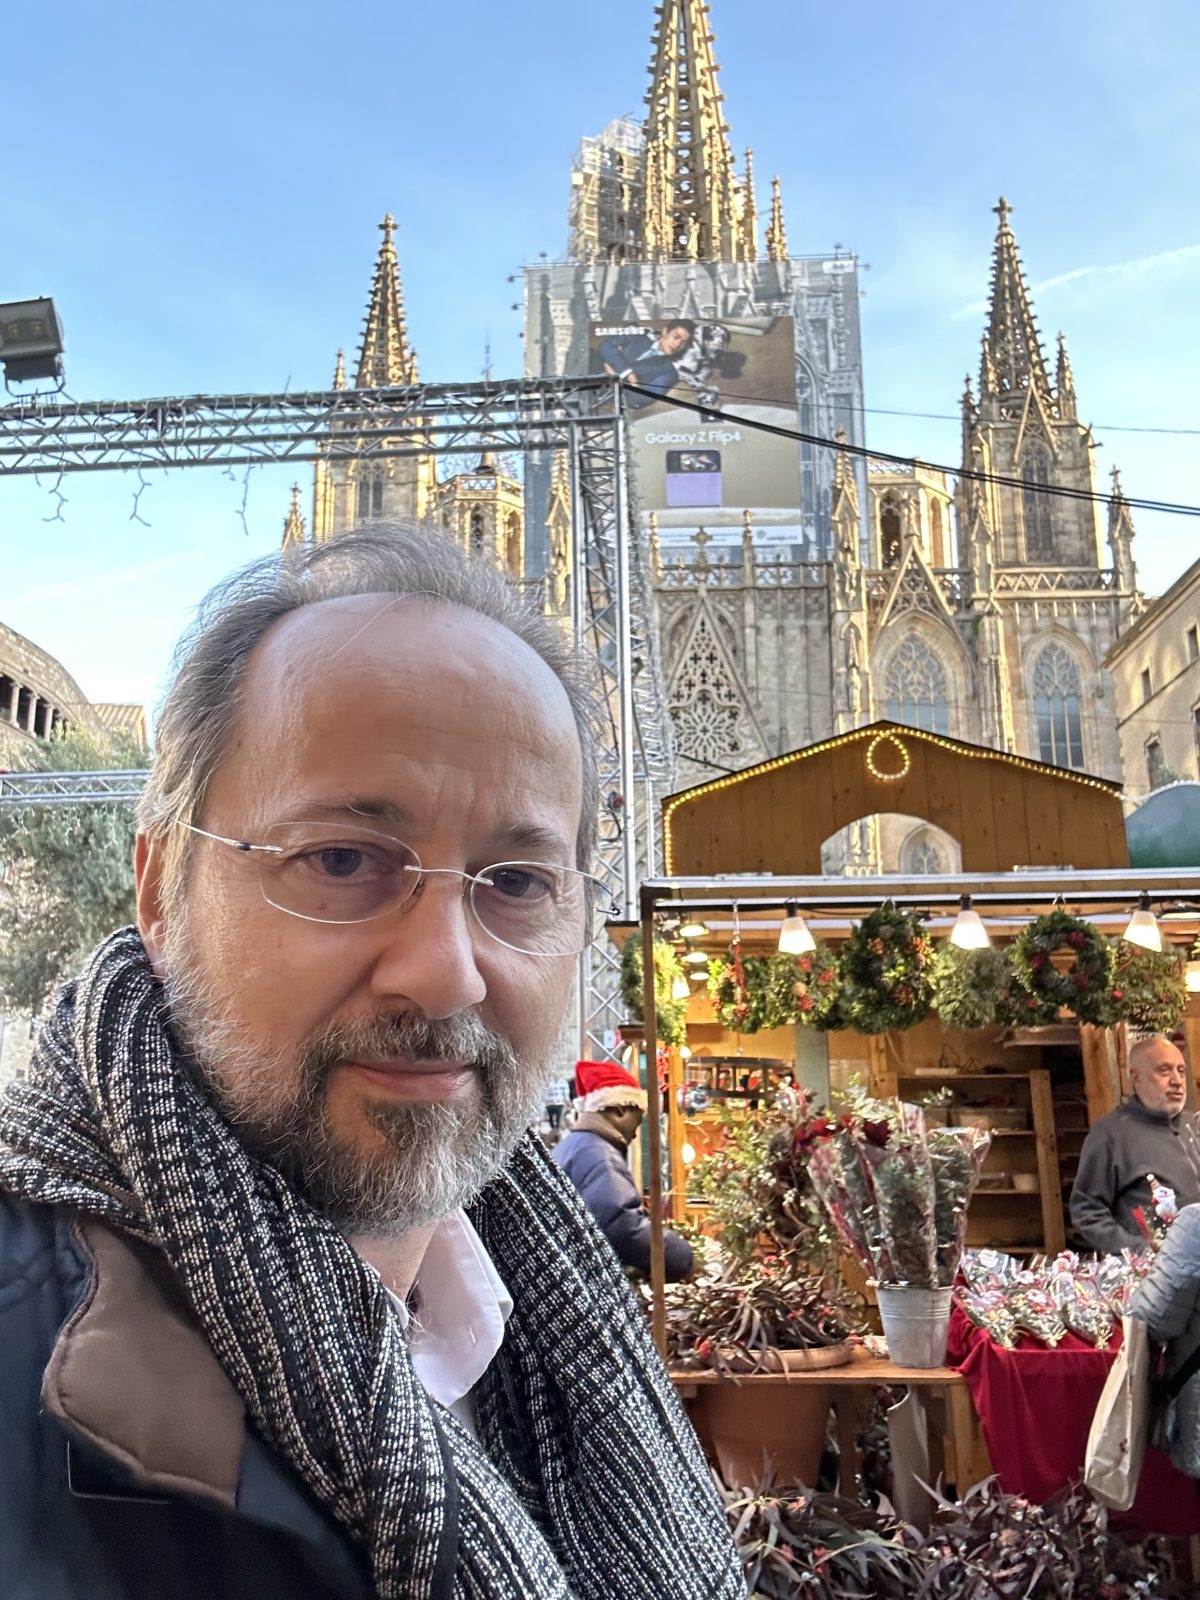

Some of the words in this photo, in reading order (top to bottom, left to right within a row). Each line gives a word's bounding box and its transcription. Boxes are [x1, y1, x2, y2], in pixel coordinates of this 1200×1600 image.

[594, 326, 646, 336] SAMSUNG
[645, 432, 697, 446] Galaxy
[697, 431, 707, 443] Z
[708, 430, 742, 446] Flip4
